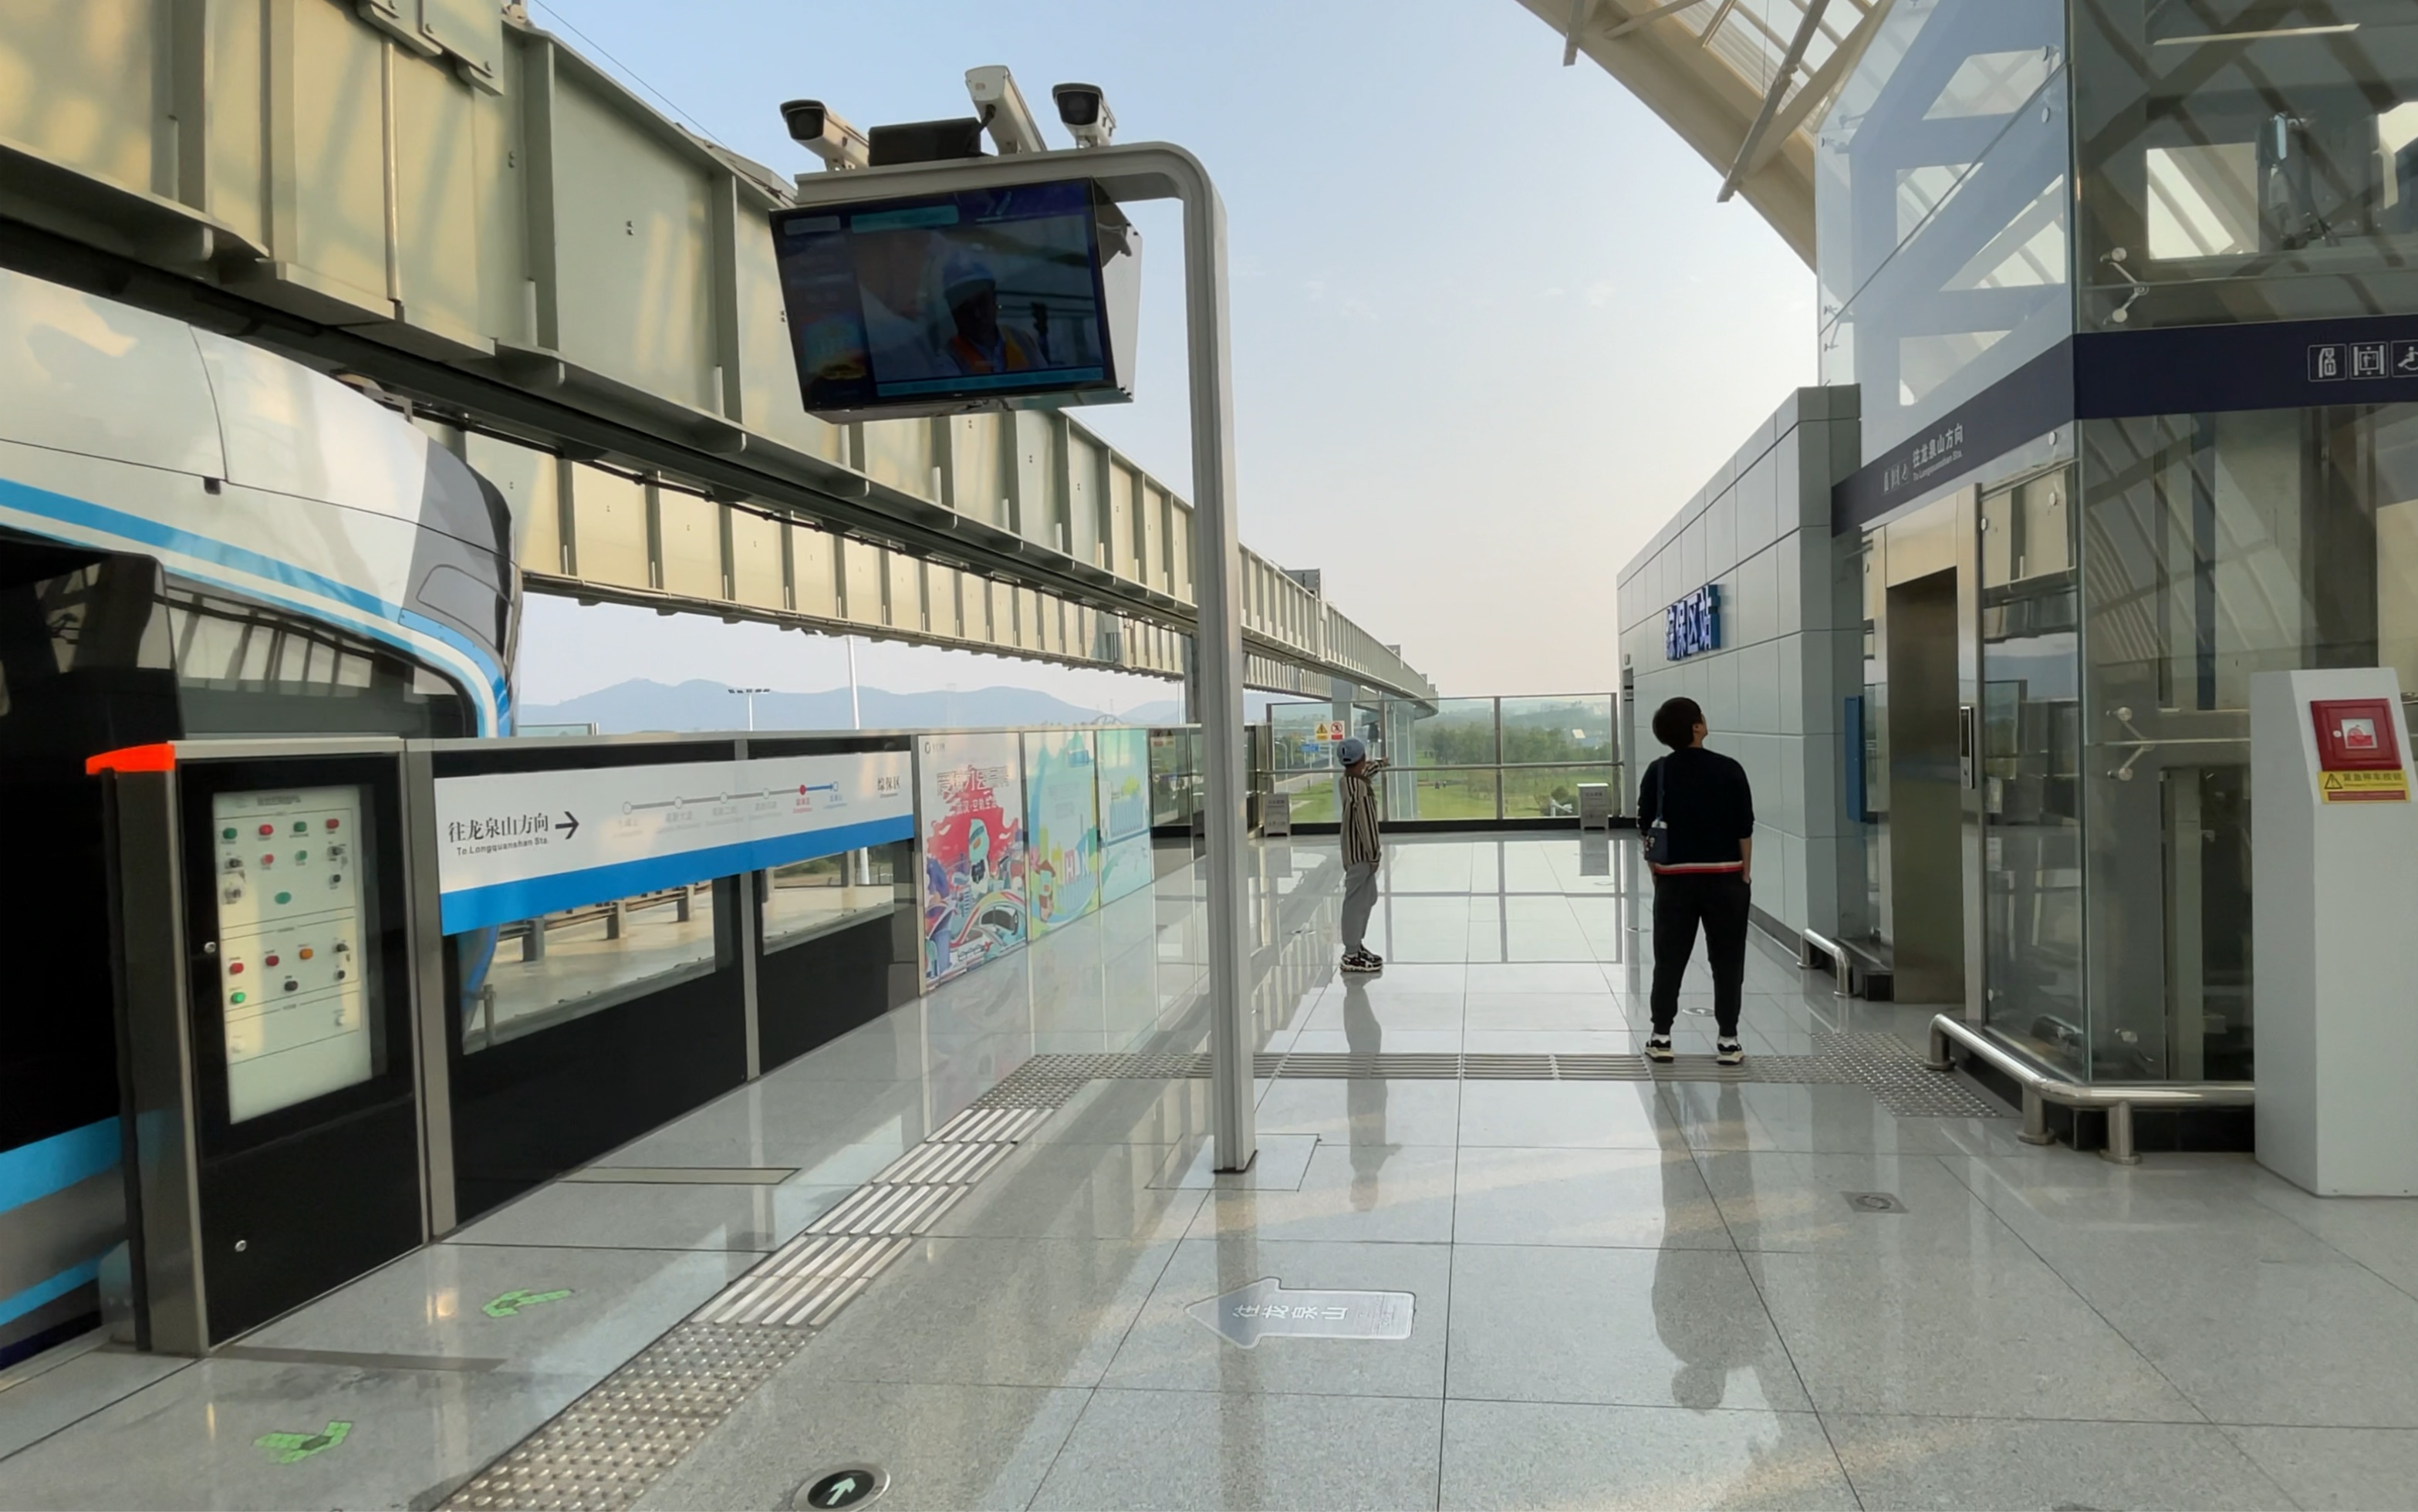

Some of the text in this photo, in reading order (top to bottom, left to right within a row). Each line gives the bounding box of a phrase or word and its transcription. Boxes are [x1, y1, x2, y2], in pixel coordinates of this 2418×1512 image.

[1913, 423, 1963, 468] 往龙泉山方向
[877, 775, 900, 791] 综保区
[448, 812, 549, 843] 往龙泉山方向
[457, 847, 467, 856] To
[469, 839, 533, 855] Longquanshan
[1232, 1304, 1349, 1321] 往龙泉山
